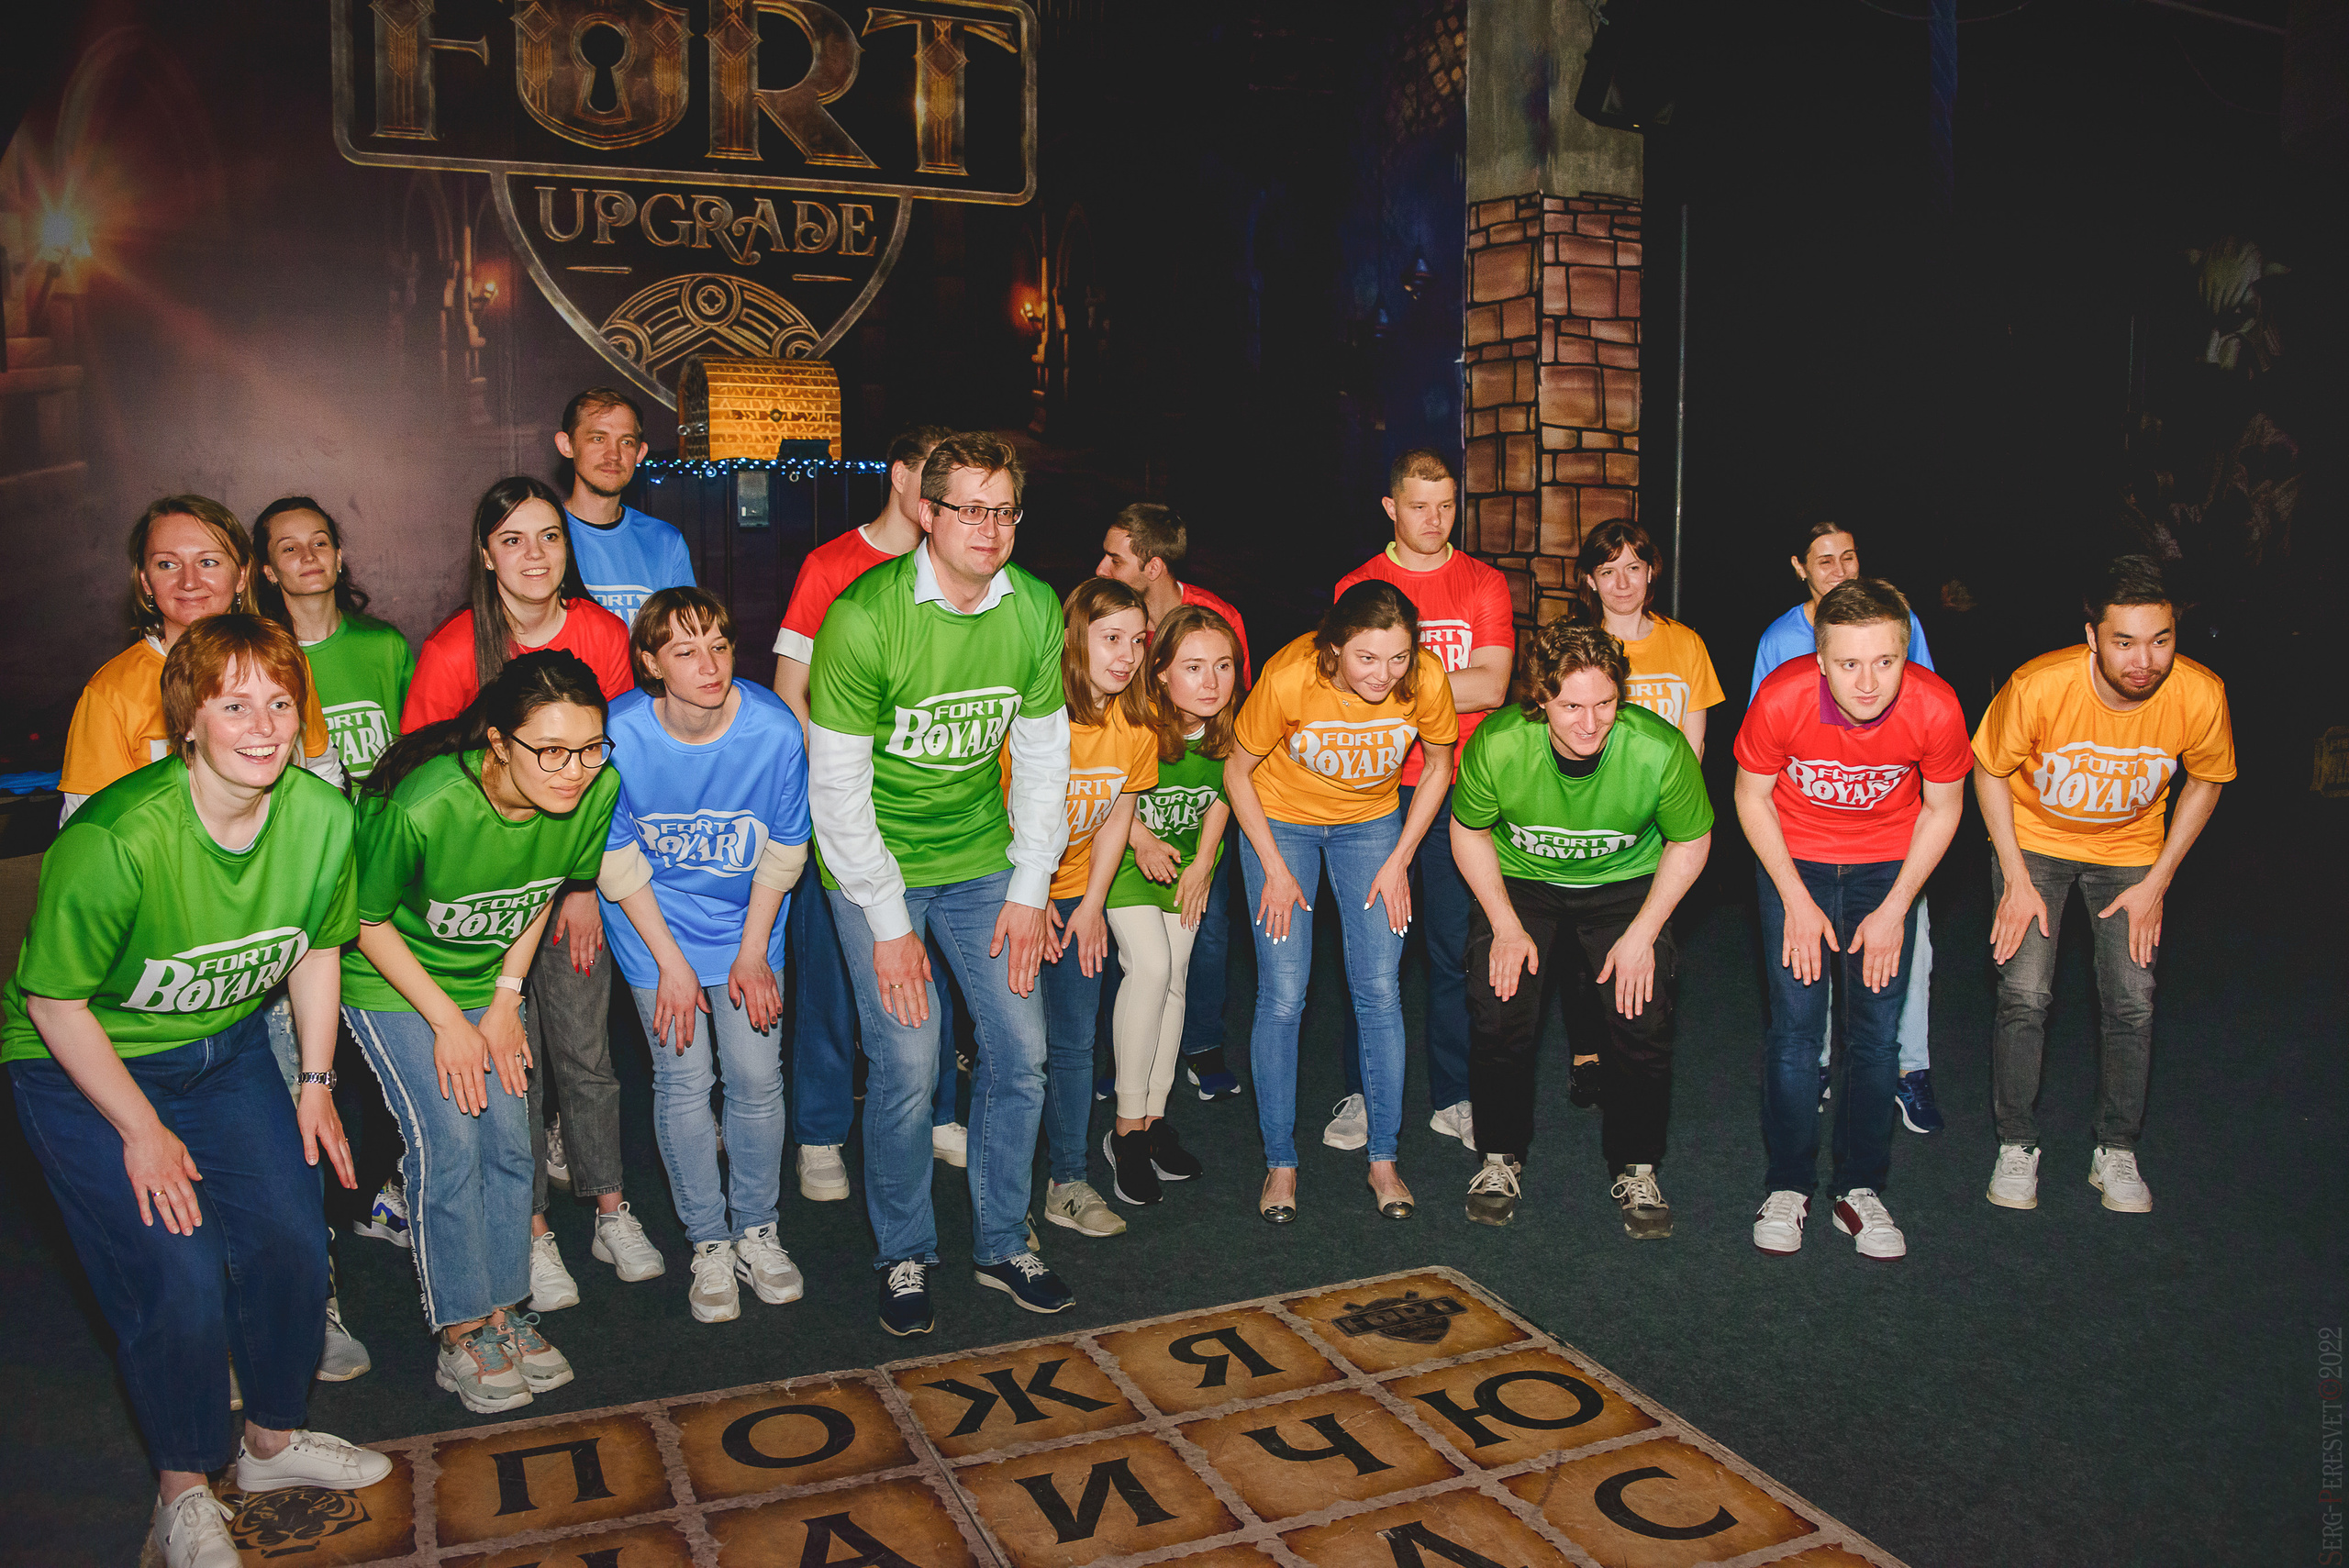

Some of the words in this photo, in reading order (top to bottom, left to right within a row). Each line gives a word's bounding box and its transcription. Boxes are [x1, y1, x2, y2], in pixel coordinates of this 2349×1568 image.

[373, 0, 1019, 176] FORT
[534, 185, 878, 265] UPGRADE
[593, 594, 636, 606] ORT
[1419, 628, 1456, 643] RT
[1624, 683, 1665, 697] ORT
[934, 699, 998, 720] FORT
[885, 695, 1023, 758] BOYARD
[1322, 730, 1387, 746] FORT
[1289, 725, 1419, 779] BOYARD
[1818, 768, 1882, 782] FORT
[2073, 753, 2143, 775] FORT
[2032, 751, 2177, 812] BOYARD
[1149, 792, 1198, 806] ORT
[661, 818, 731, 835] FORT
[1539, 834, 1602, 847] FORT
[426, 879, 565, 939] BOYAR
[473, 890, 546, 912] FORT
[195, 943, 277, 976] FORT
[120, 930, 308, 1012] BOYARD
[918, 1358, 1118, 1438] Ж
[1168, 1327, 1286, 1388] Я
[1241, 1413, 1396, 1475] Ч
[1412, 1370, 1604, 1449] Ю
